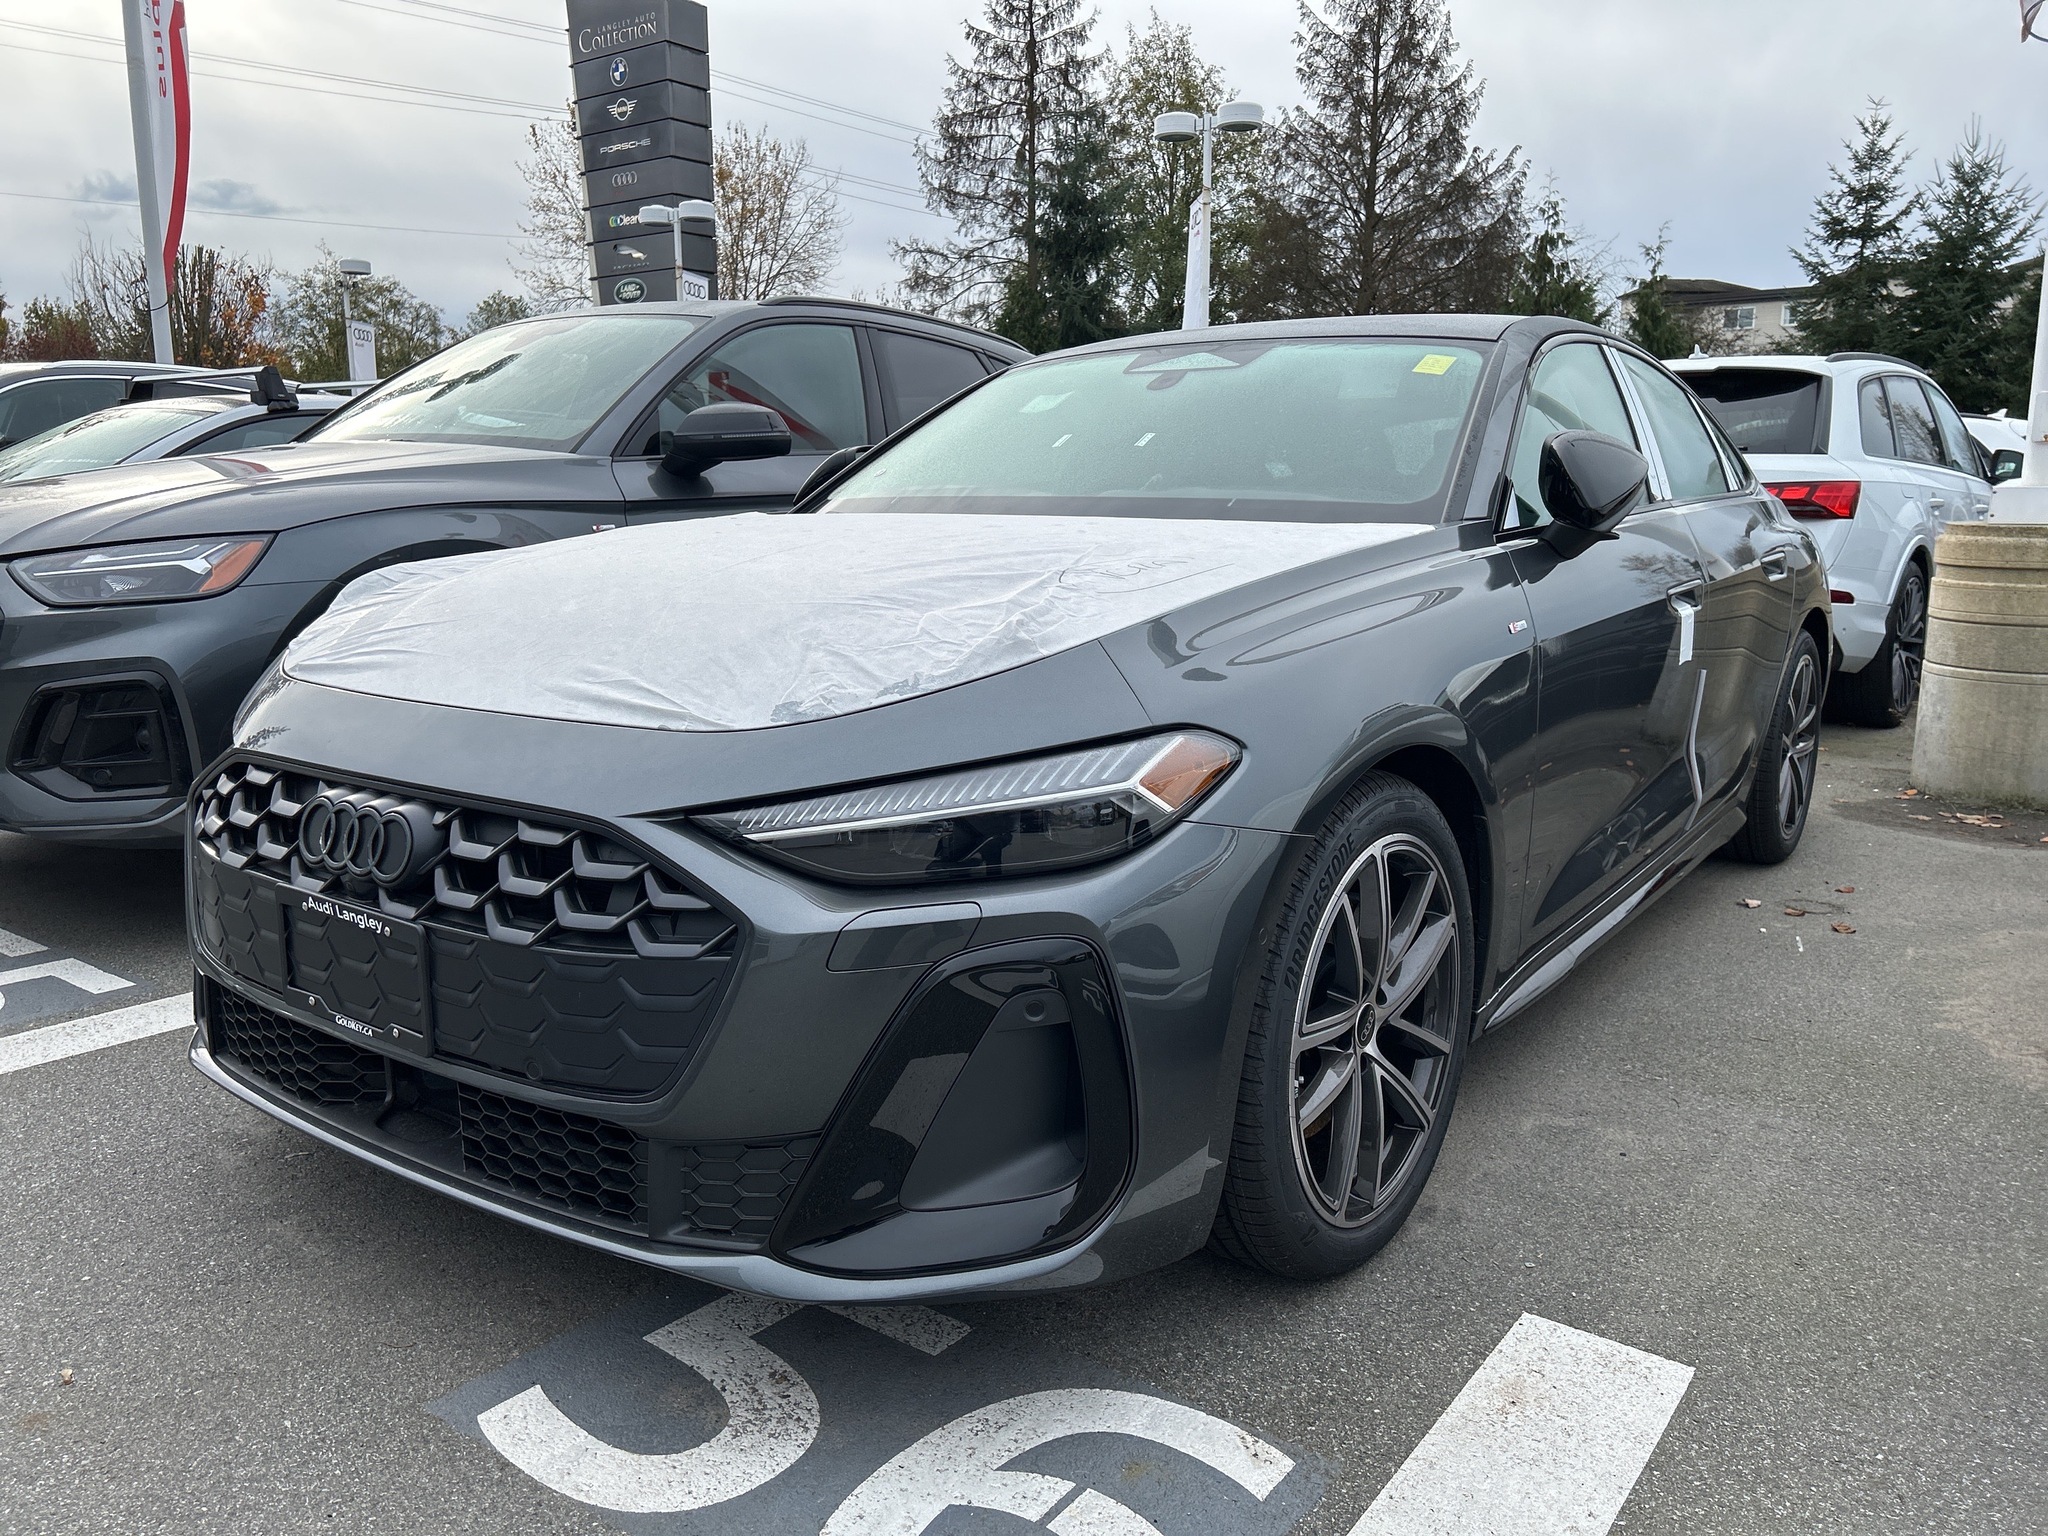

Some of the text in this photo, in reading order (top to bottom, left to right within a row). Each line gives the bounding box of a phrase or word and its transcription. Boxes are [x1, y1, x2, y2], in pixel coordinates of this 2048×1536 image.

[597, 11, 656, 34] LANGLEY AUTO
[600, 137, 651, 154] PORSCHE
[308, 896, 383, 933] Audi Langley
[1284, 832, 1356, 997] BRIDGESTONE
